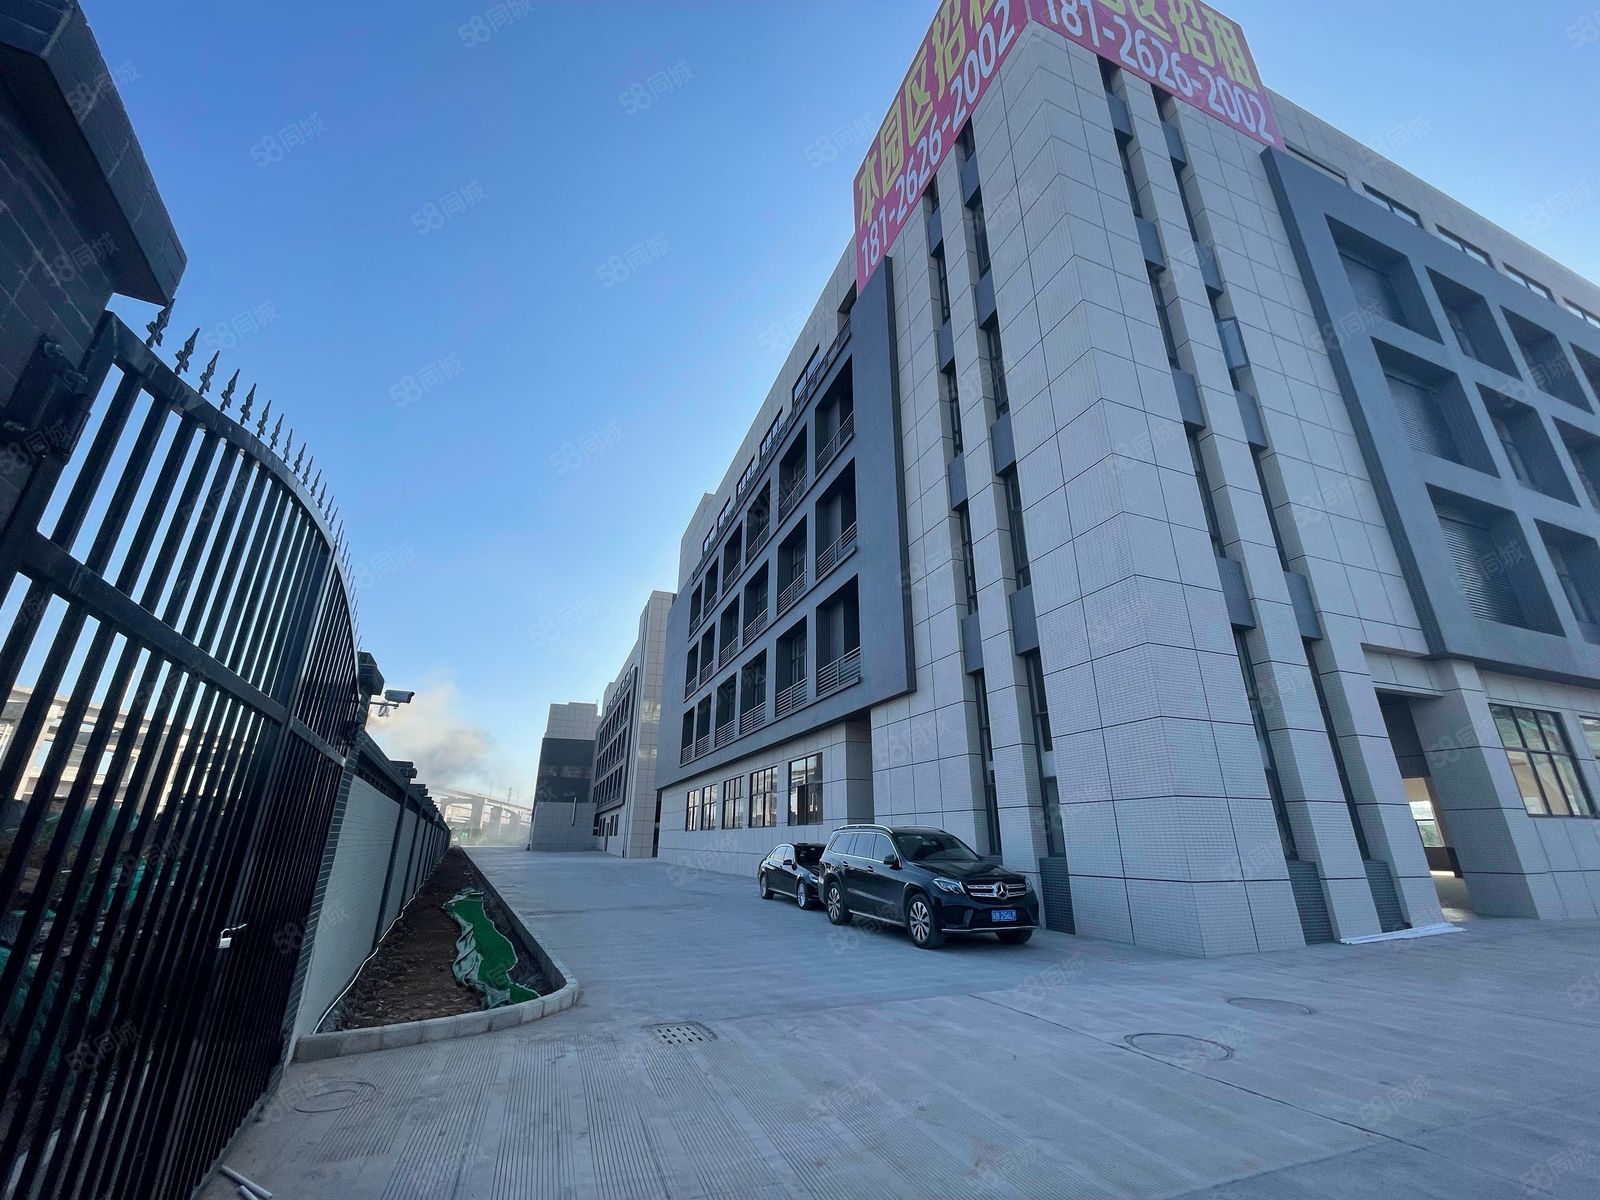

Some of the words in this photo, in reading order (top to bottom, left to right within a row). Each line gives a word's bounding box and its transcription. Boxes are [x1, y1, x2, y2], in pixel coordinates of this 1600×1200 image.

[861, 0, 1015, 277] 181-2626-2002
[1099, 0, 1258, 93] 区招租
